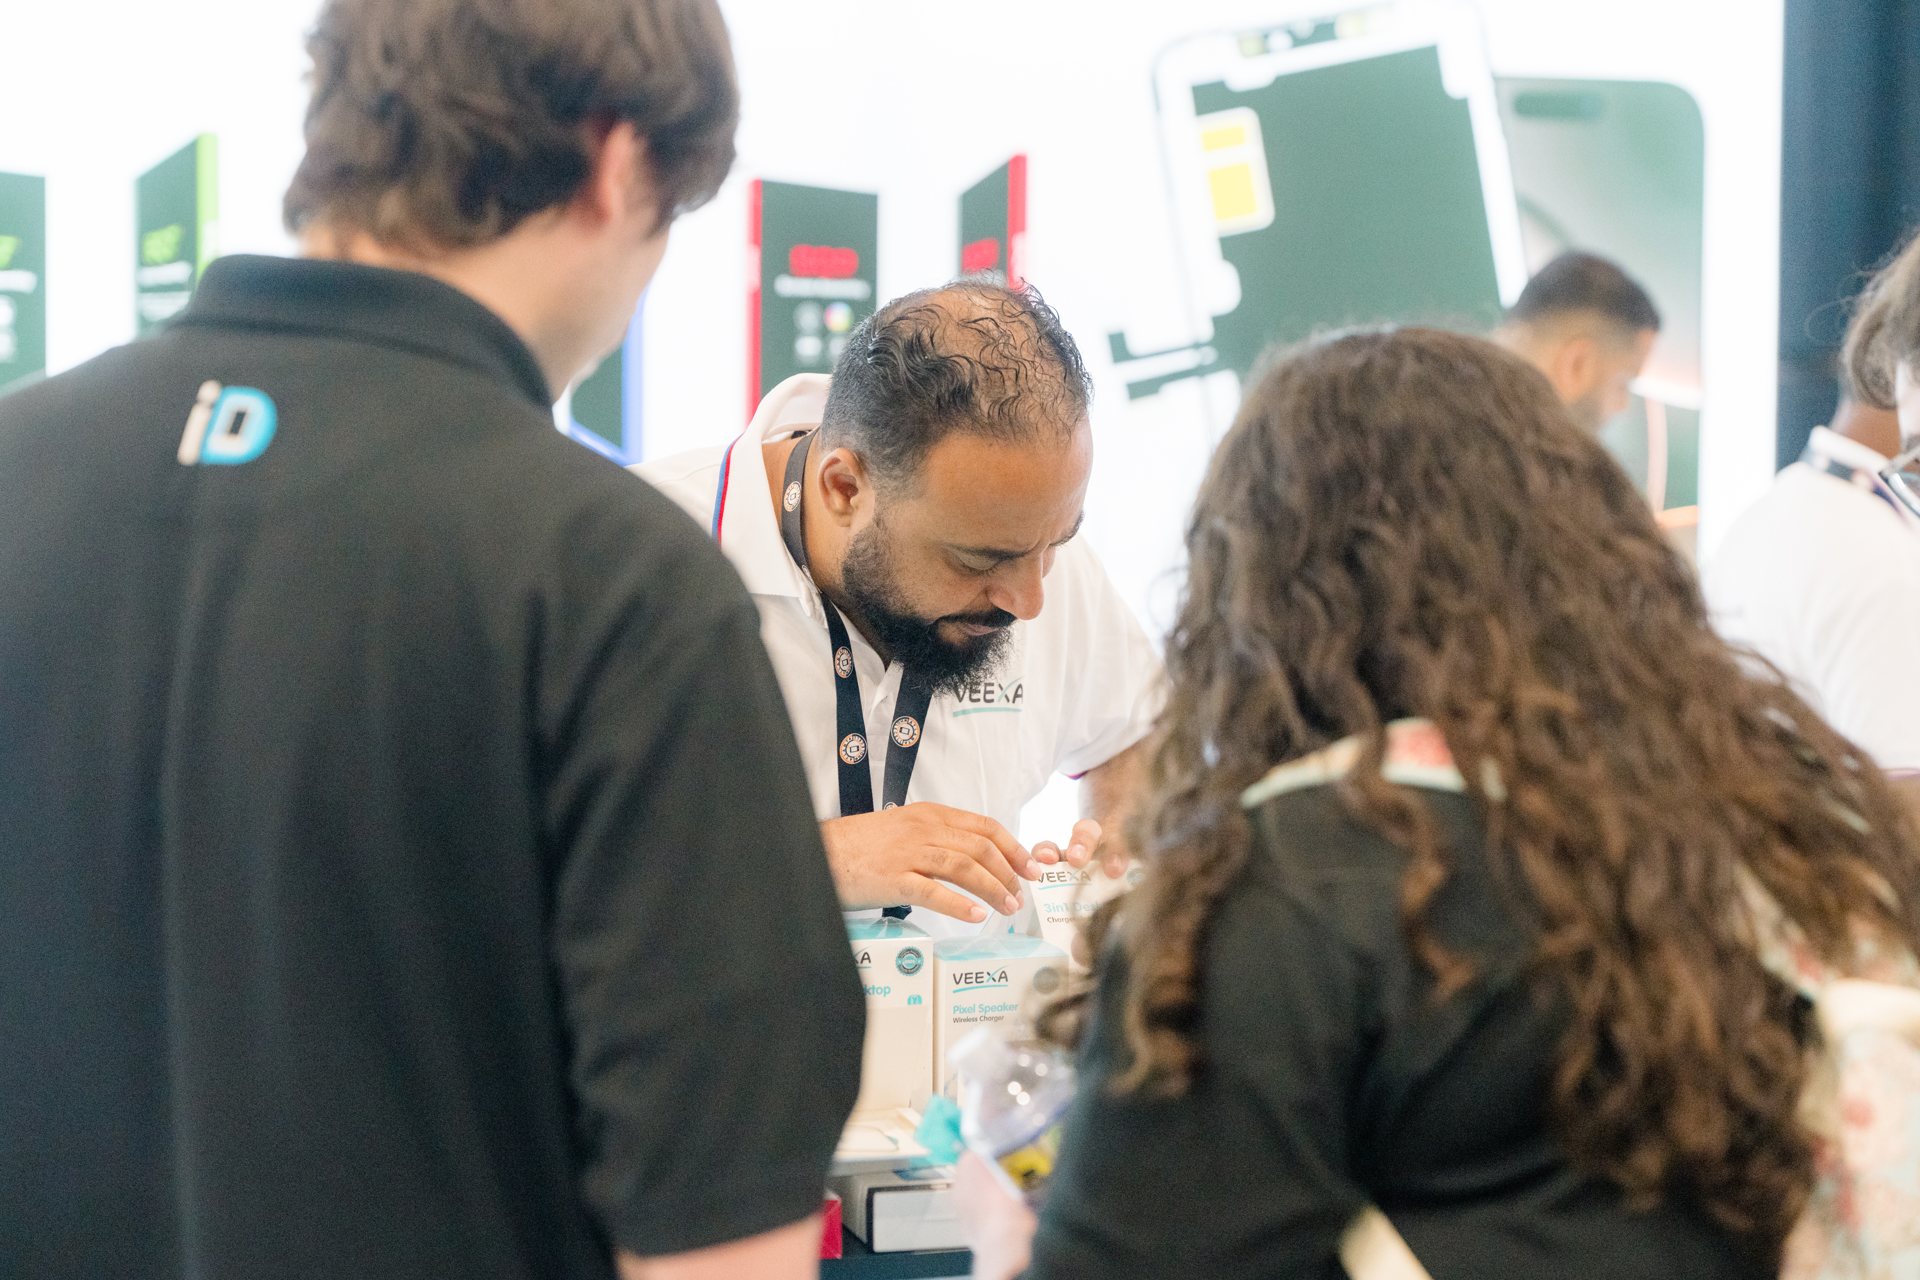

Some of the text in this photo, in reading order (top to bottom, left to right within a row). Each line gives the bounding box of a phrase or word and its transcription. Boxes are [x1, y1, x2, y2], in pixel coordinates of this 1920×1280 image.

[952, 677, 1024, 704] VEEXA
[952, 966, 1008, 985] VEEXA
[953, 1002, 1018, 1016] Pixel Speaker
[953, 1015, 1004, 1024] Wireless Charger
